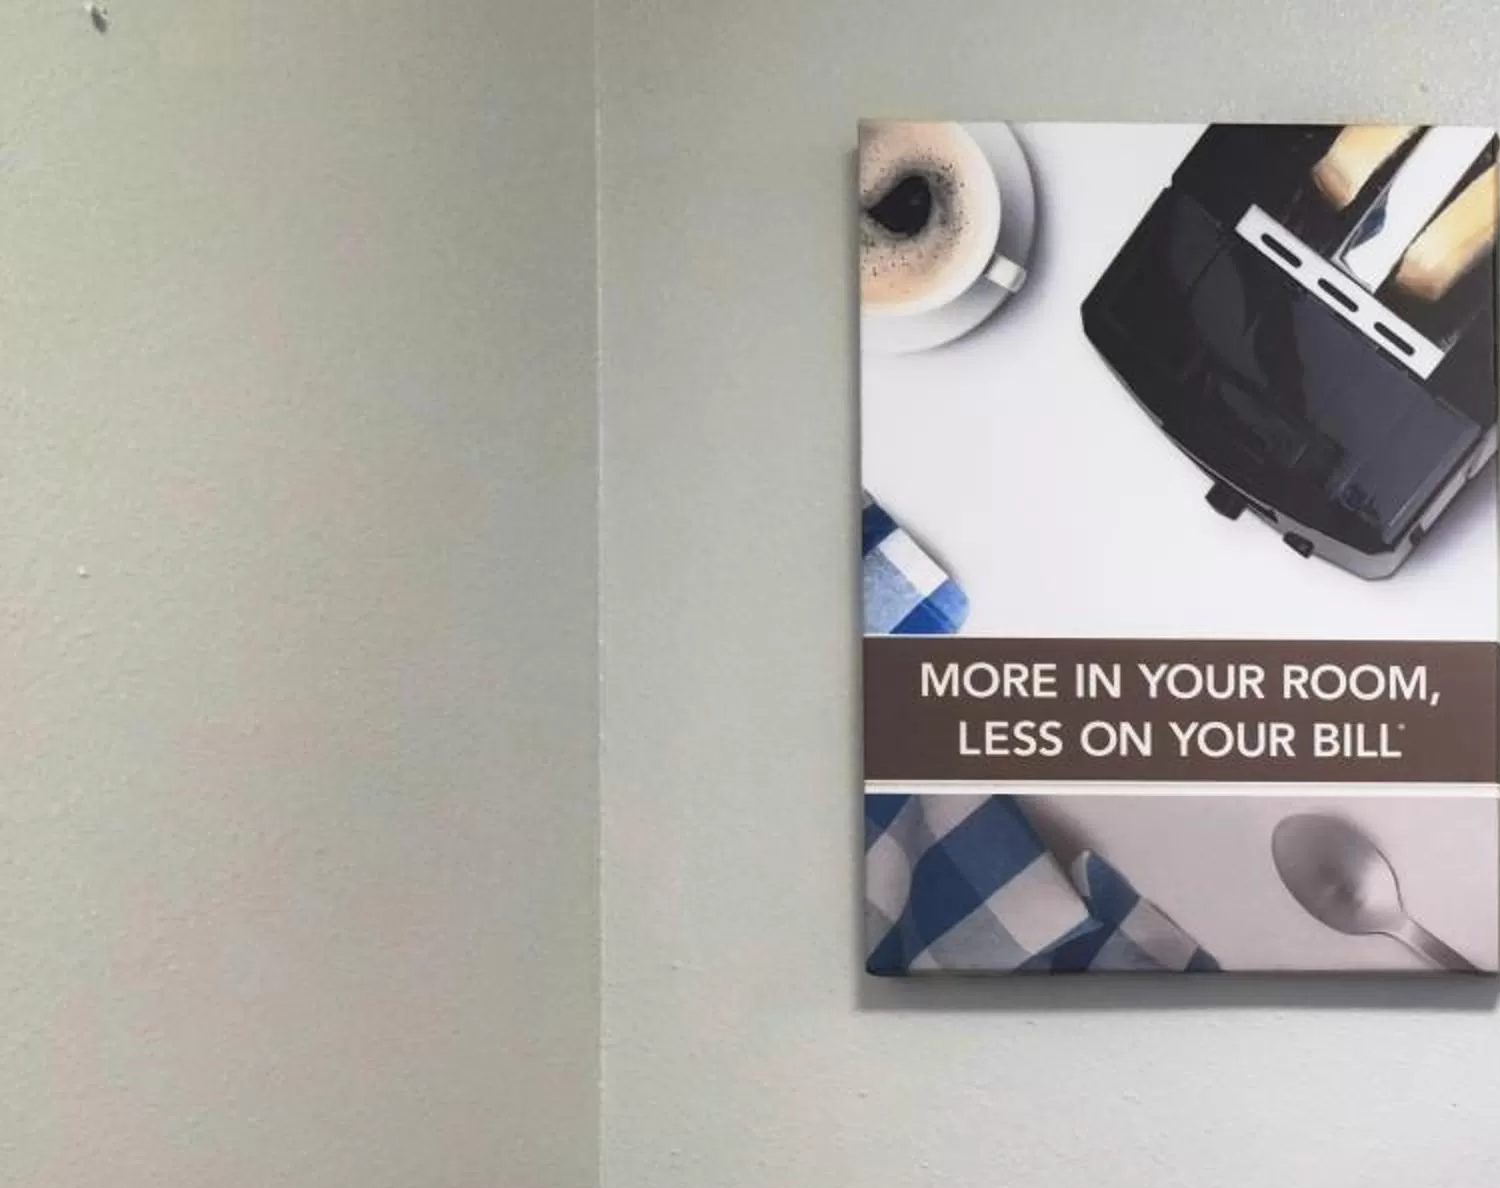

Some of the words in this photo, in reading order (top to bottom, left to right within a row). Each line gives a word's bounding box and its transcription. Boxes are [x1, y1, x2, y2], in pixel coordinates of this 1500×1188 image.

[920, 662, 1058, 699] MORE
[1075, 664, 1121, 698] IN
[1138, 665, 1266, 699] YOUR
[1282, 665, 1441, 706] ROOM,
[958, 721, 1063, 756] LESS
[1080, 721, 1152, 757] ON
[1169, 721, 1296, 757] YOUR
[1313, 723, 1402, 757] BILL
